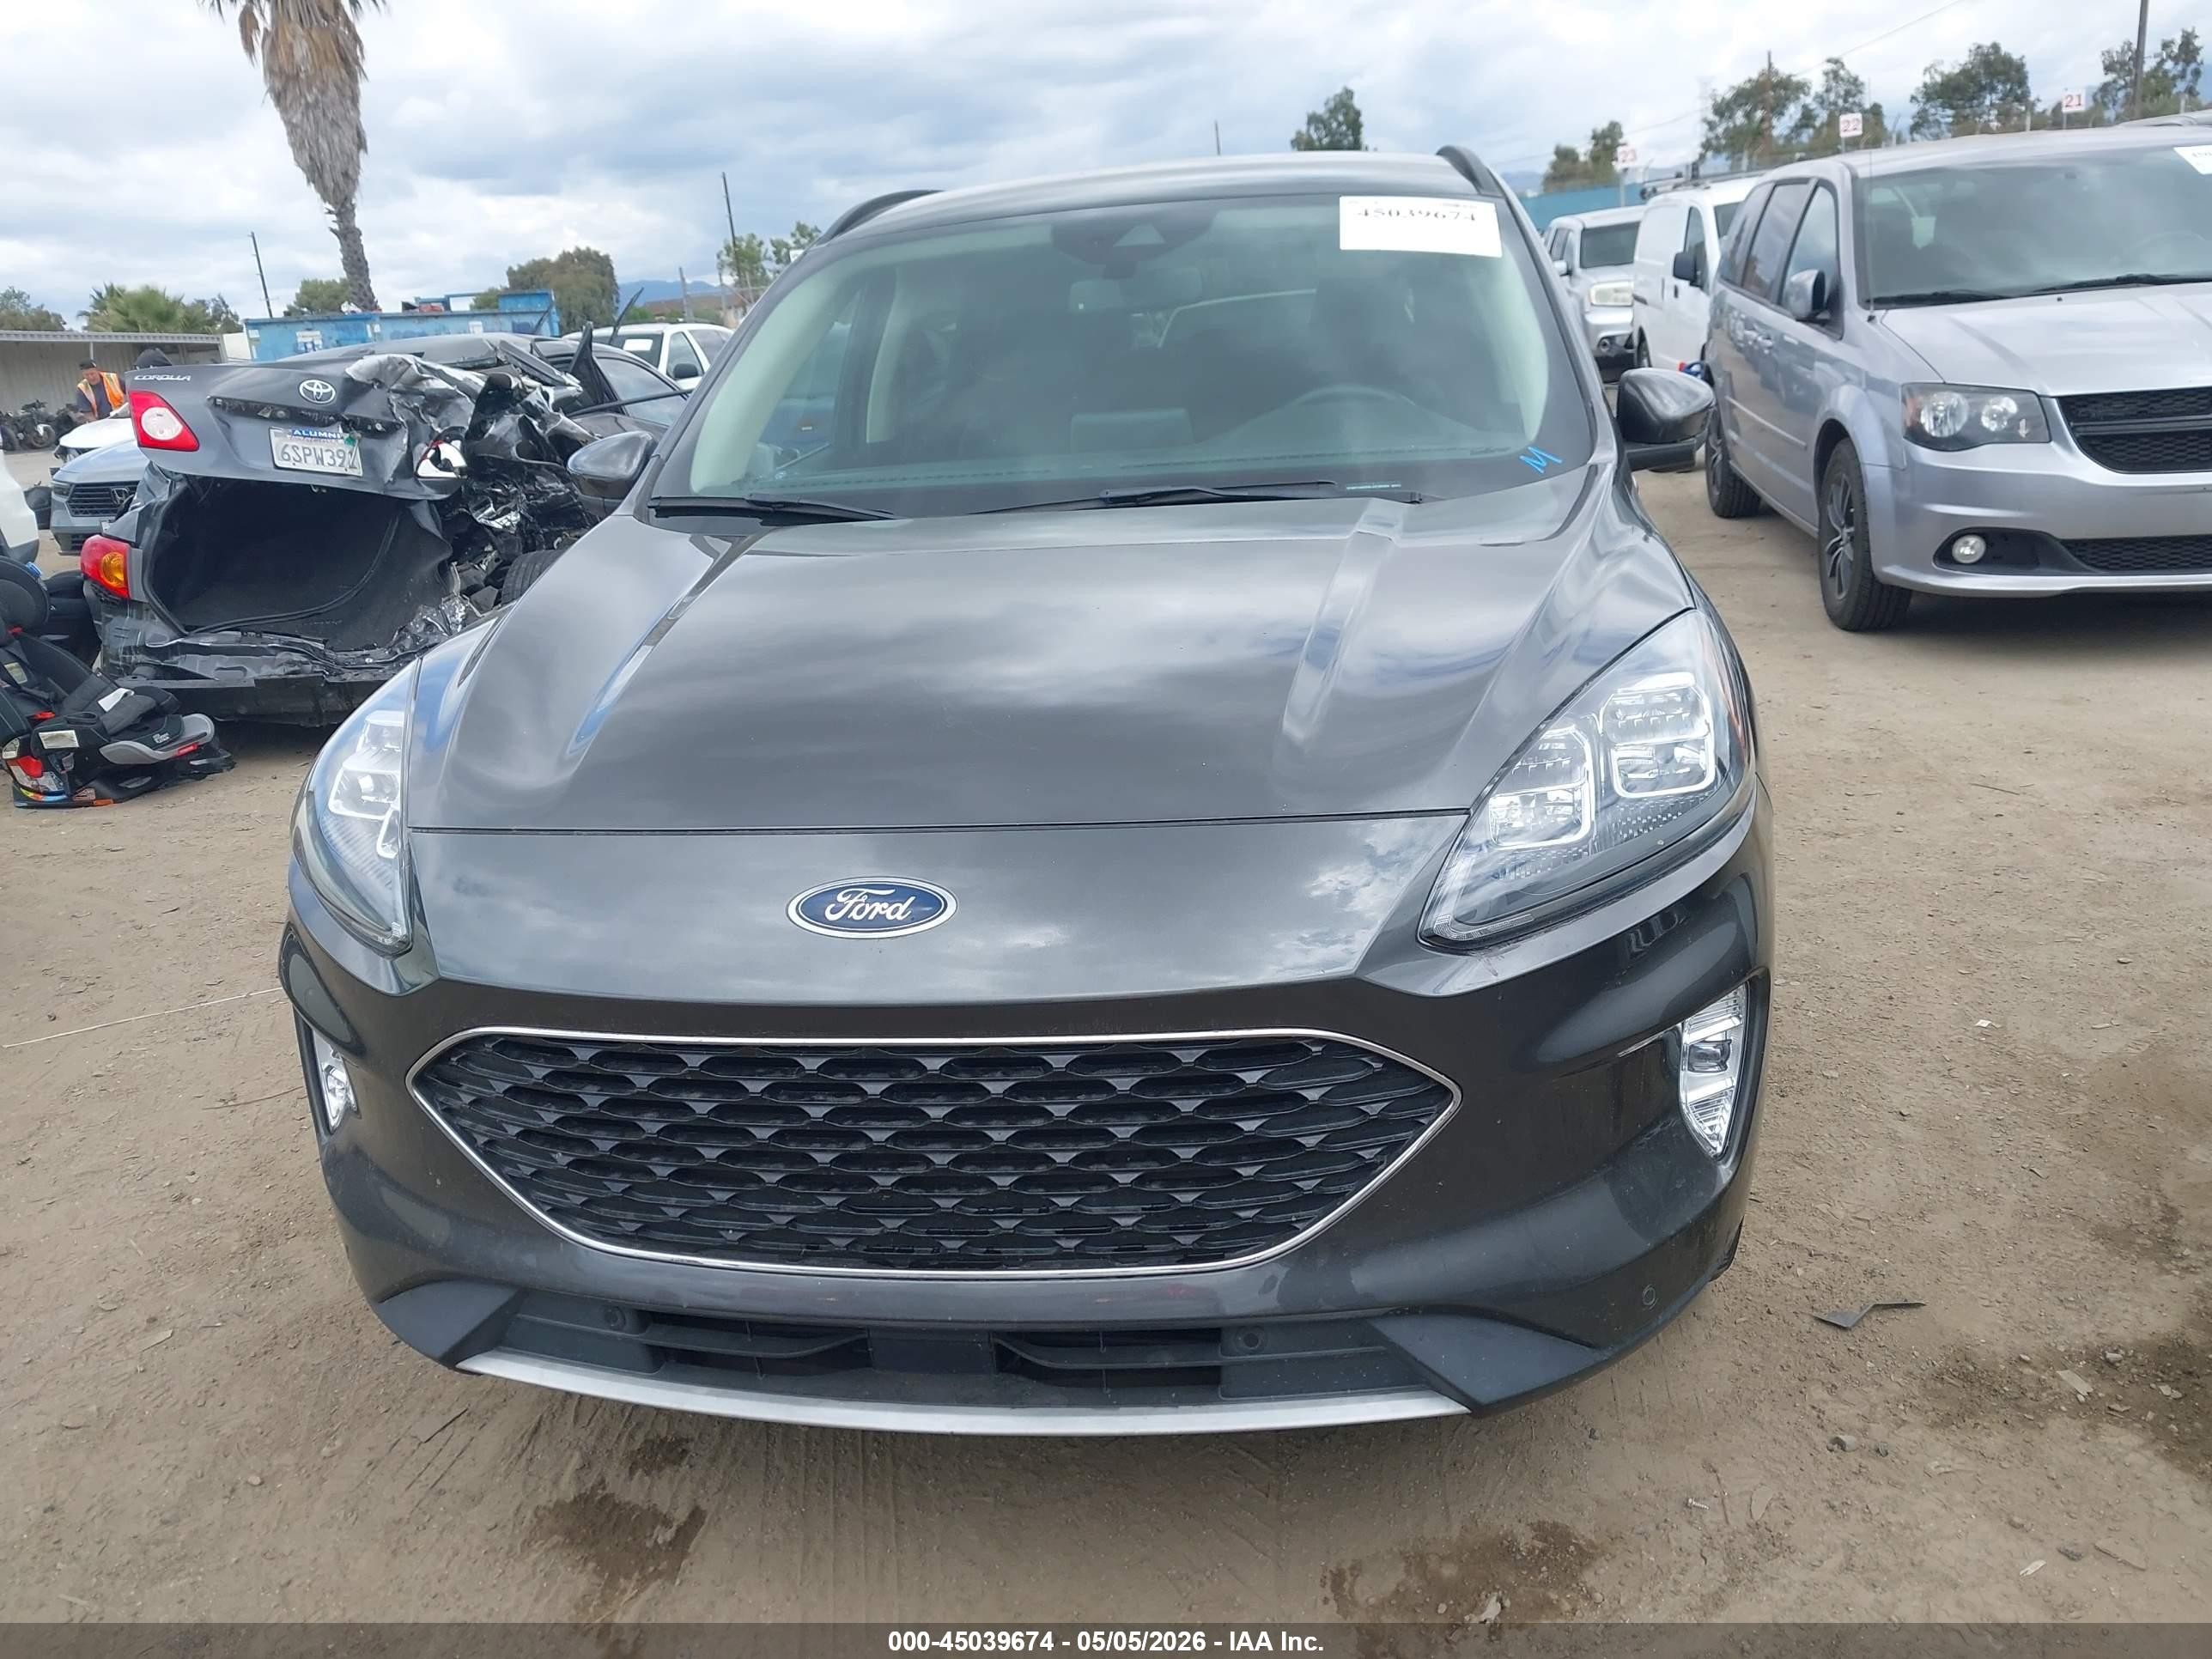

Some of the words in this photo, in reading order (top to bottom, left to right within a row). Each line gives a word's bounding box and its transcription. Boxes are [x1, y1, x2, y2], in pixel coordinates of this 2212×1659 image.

[2064, 94, 2082, 108] 21
[1841, 118, 1860, 133] 22
[134, 374, 191, 382] COROLLA
[293, 428, 342, 440] ALUMNI
[824, 887, 917, 921] Ford
